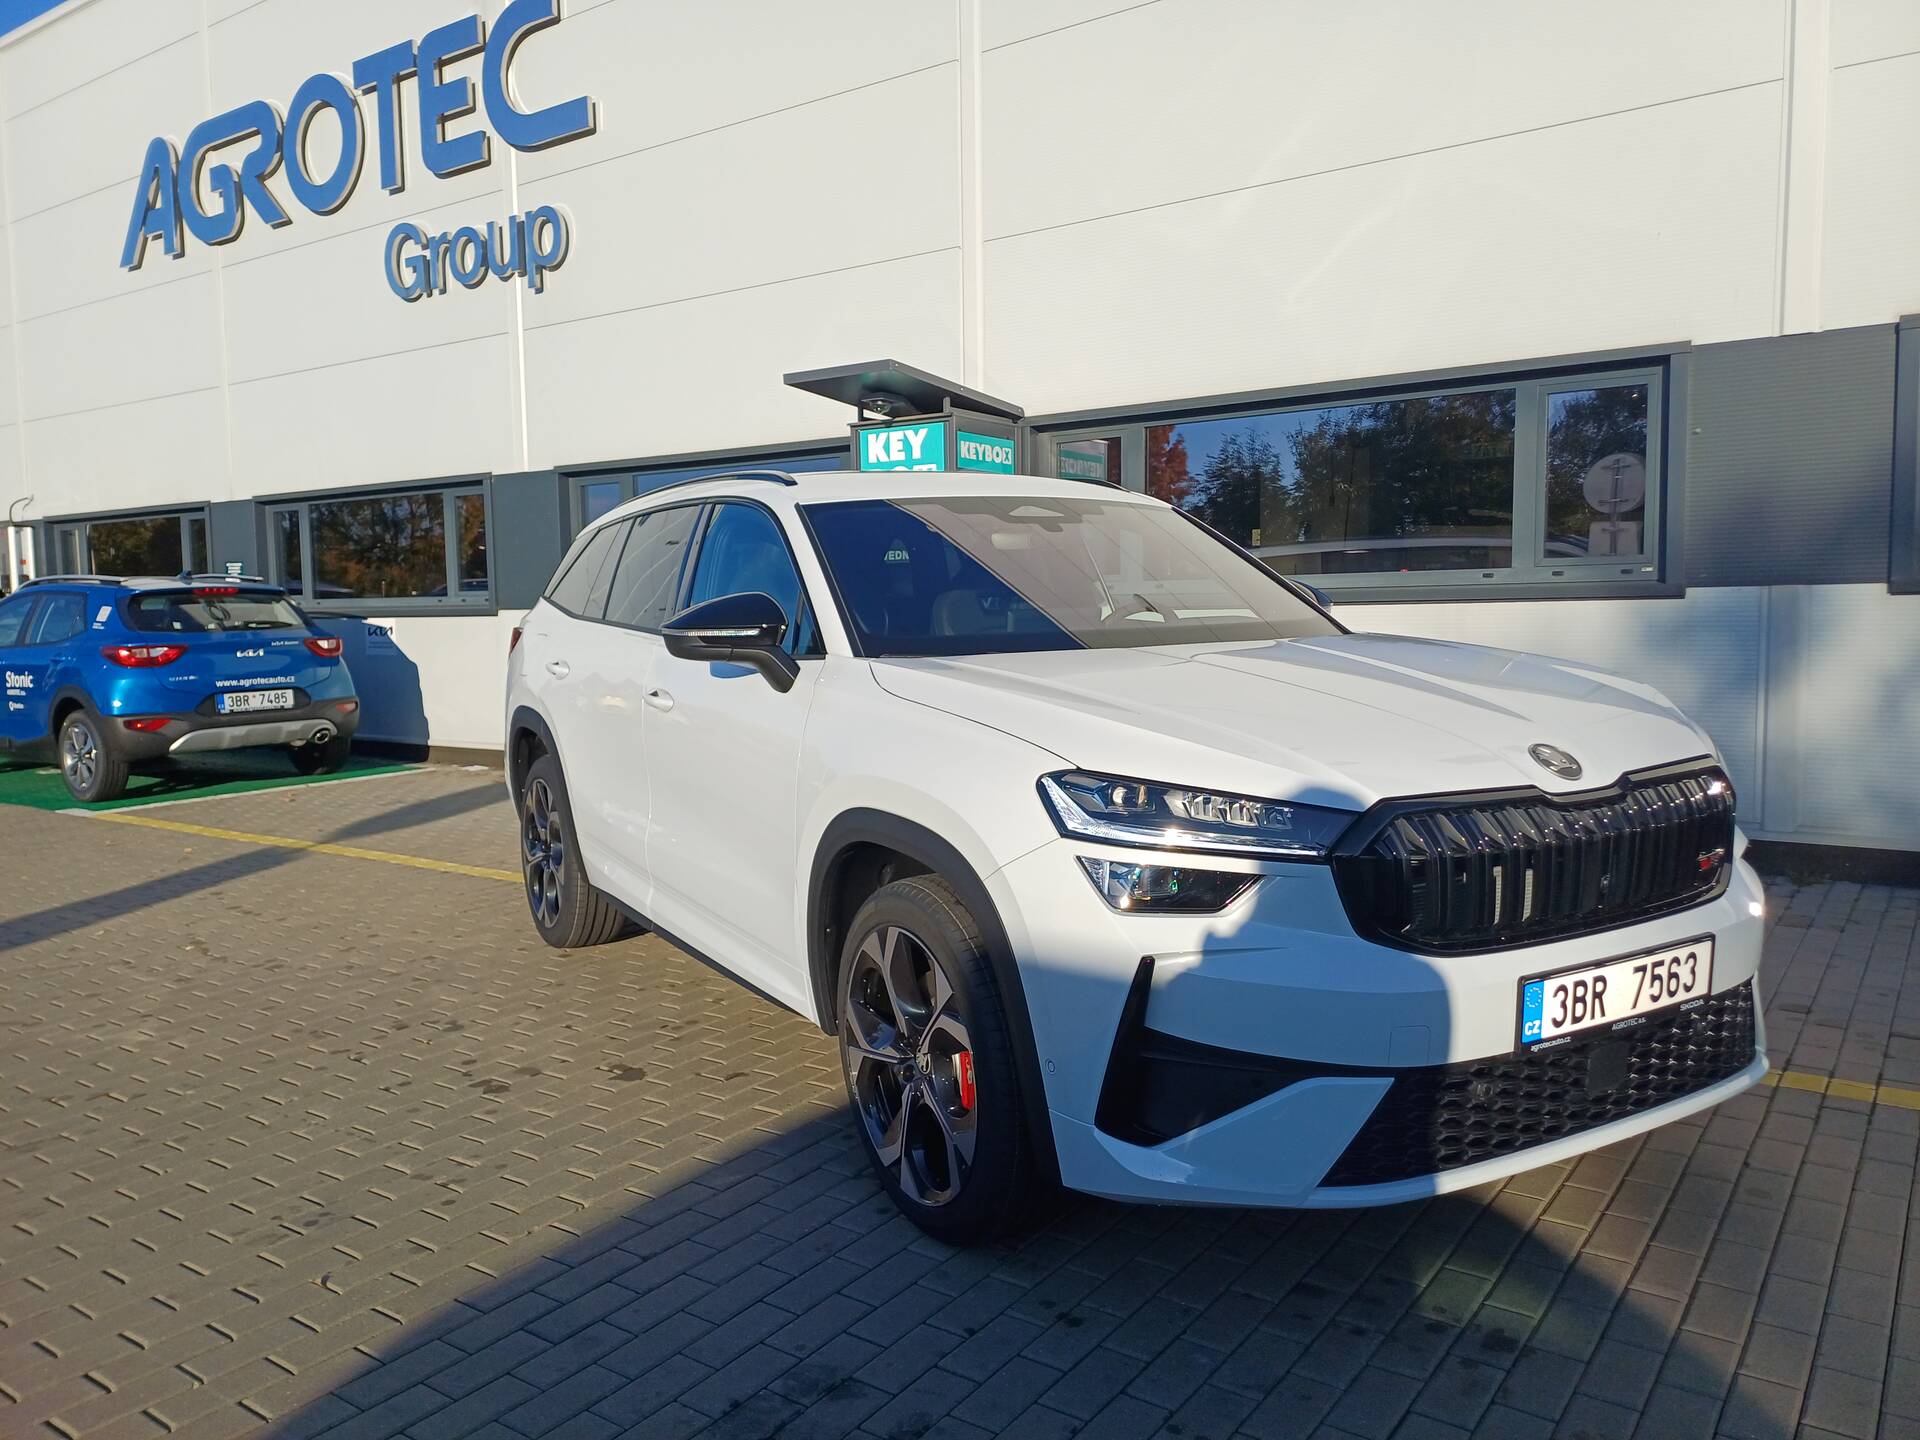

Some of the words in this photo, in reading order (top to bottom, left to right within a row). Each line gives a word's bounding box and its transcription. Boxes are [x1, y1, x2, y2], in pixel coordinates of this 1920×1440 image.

[120, 0, 596, 271] AGROTEC
[384, 205, 569, 303] Group
[867, 427, 929, 464] KEY
[960, 440, 1012, 465] KEYBOX
[5, 670, 34, 688] Stonic
[215, 675, 296, 687] www.agrotecauto.cz
[227, 694, 250, 708] 3BR
[258, 692, 288, 705] 7485
[1550, 974, 1608, 1029] 3BR
[1629, 951, 1698, 1010] 7563
[1524, 1019, 1541, 1036] CZ
[1611, 1017, 1638, 1031] AGROTEC
[1530, 1036, 1571, 1053] agrotecauto.cz
